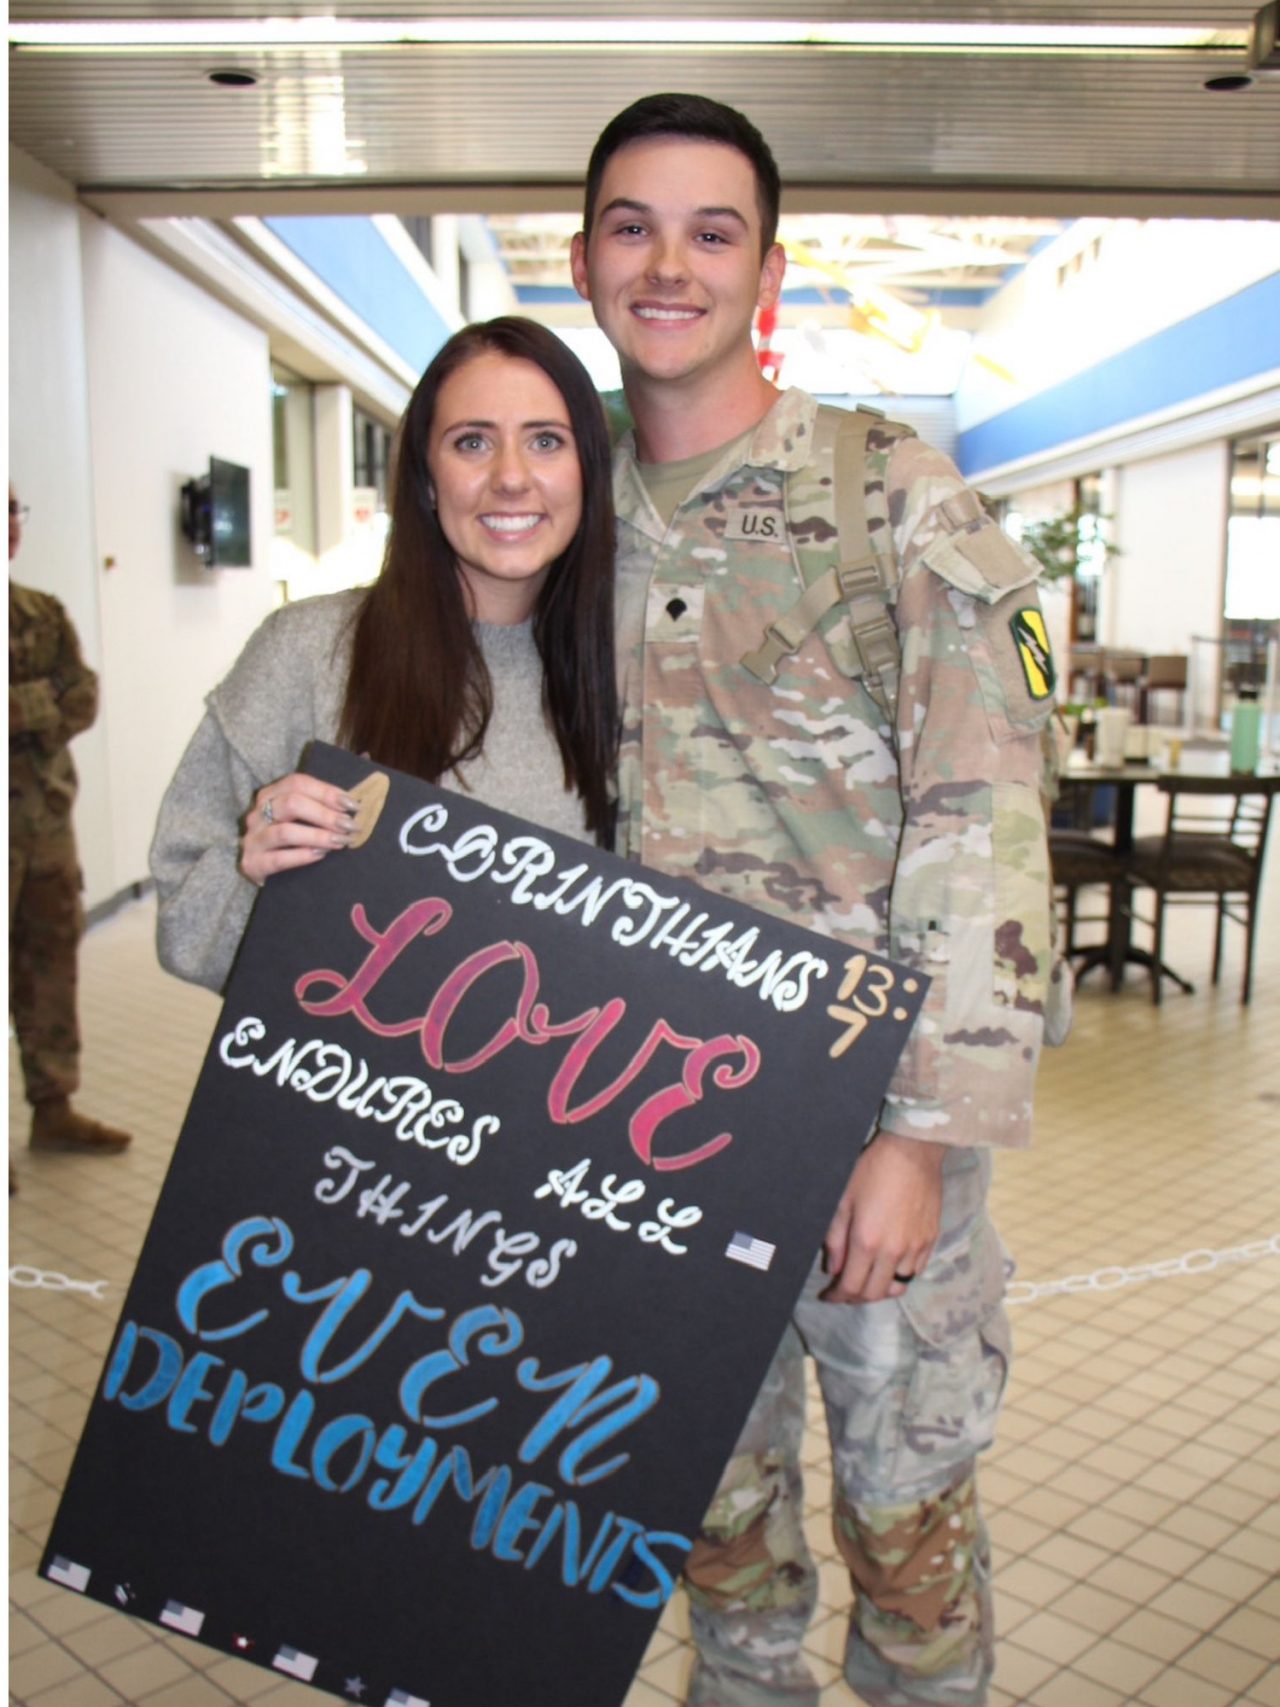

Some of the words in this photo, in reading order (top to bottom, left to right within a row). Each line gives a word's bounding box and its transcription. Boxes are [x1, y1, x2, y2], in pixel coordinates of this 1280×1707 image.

[742, 514, 778, 538] U.S.
[399, 803, 829, 1012] CORINTHIANS
[220, 1017, 500, 1165] ENDURES
[534, 1159, 702, 1254] ALL
[295, 898, 761, 1171] LOVE
[315, 1145, 577, 1288] THINGS
[104, 1320, 693, 1608] DEPLOYMENTS
[177, 1217, 660, 1486] EVEN
